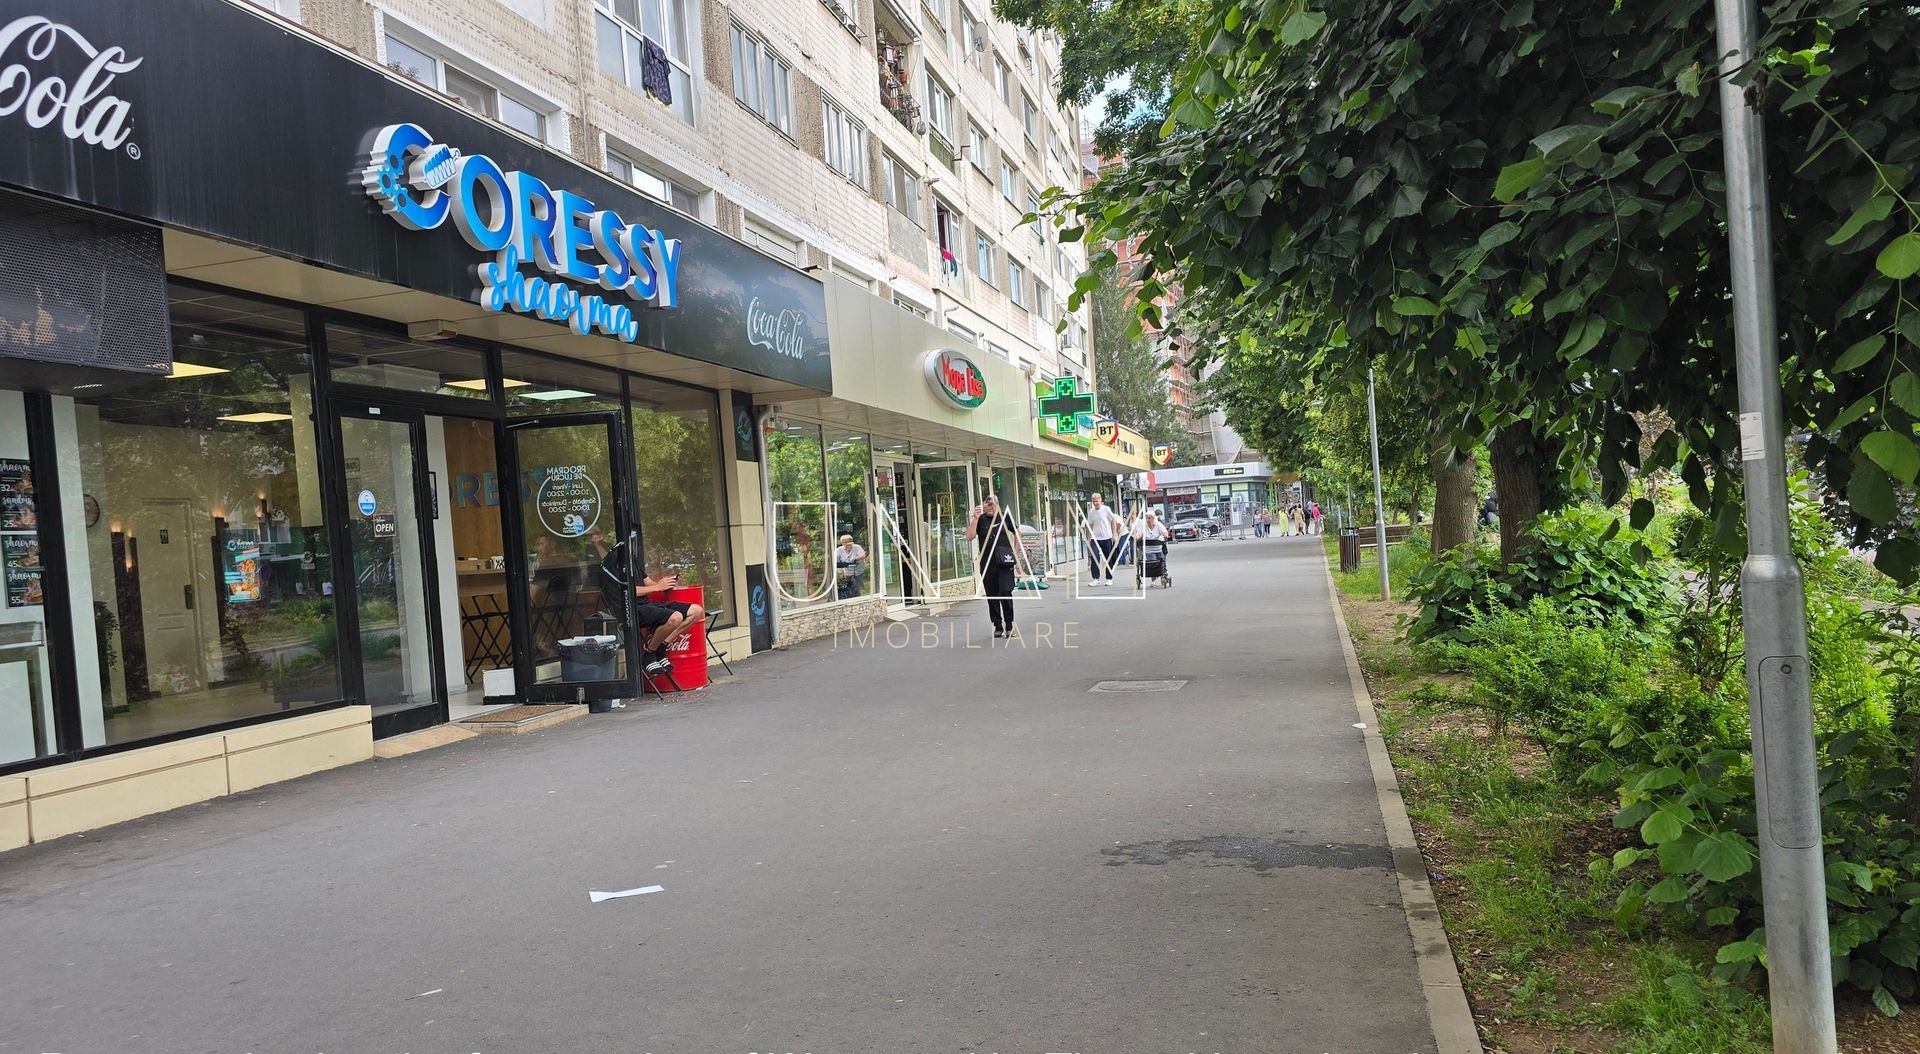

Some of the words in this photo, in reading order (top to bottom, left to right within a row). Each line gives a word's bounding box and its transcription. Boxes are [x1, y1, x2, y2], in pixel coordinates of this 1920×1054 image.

[361, 122, 683, 308] CORESSY
[478, 246, 640, 343] shaorma
[1099, 425, 1114, 436] BT
[375, 523, 395, 533] OPEN
